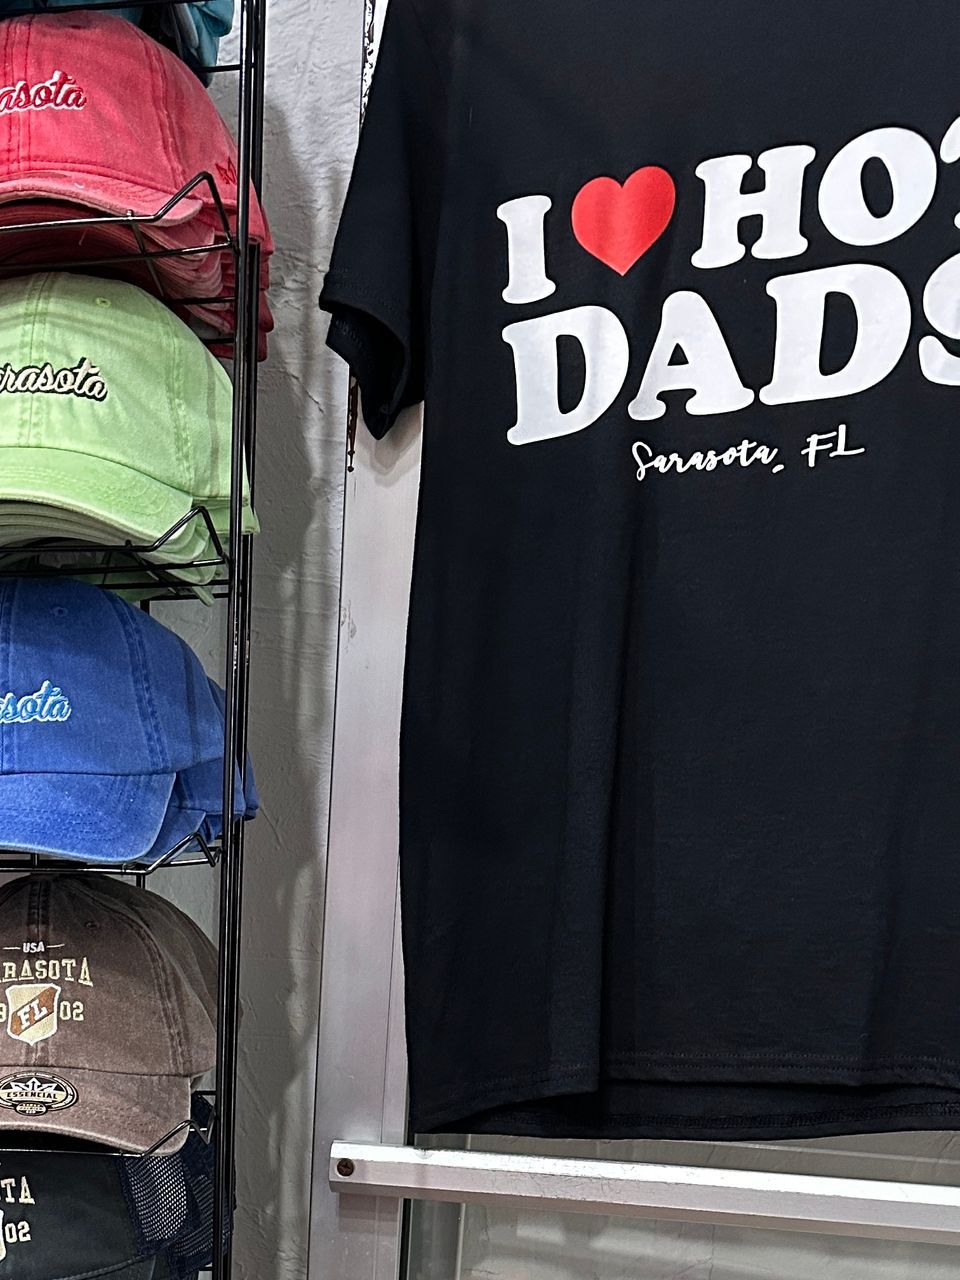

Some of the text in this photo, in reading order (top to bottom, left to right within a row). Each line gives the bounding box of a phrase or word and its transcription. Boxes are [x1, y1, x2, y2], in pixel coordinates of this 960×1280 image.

[496, 116, 960, 304] I HO
[632, 424, 865, 481] Sarasota, FL
[22, 941, 45, 953] USA
[17, 999, 48, 1030] FL
[59, 1001, 84, 1021] 02
[6, 1091, 58, 1100] ESSENCIAL
[5, 1221, 31, 1243] 02
